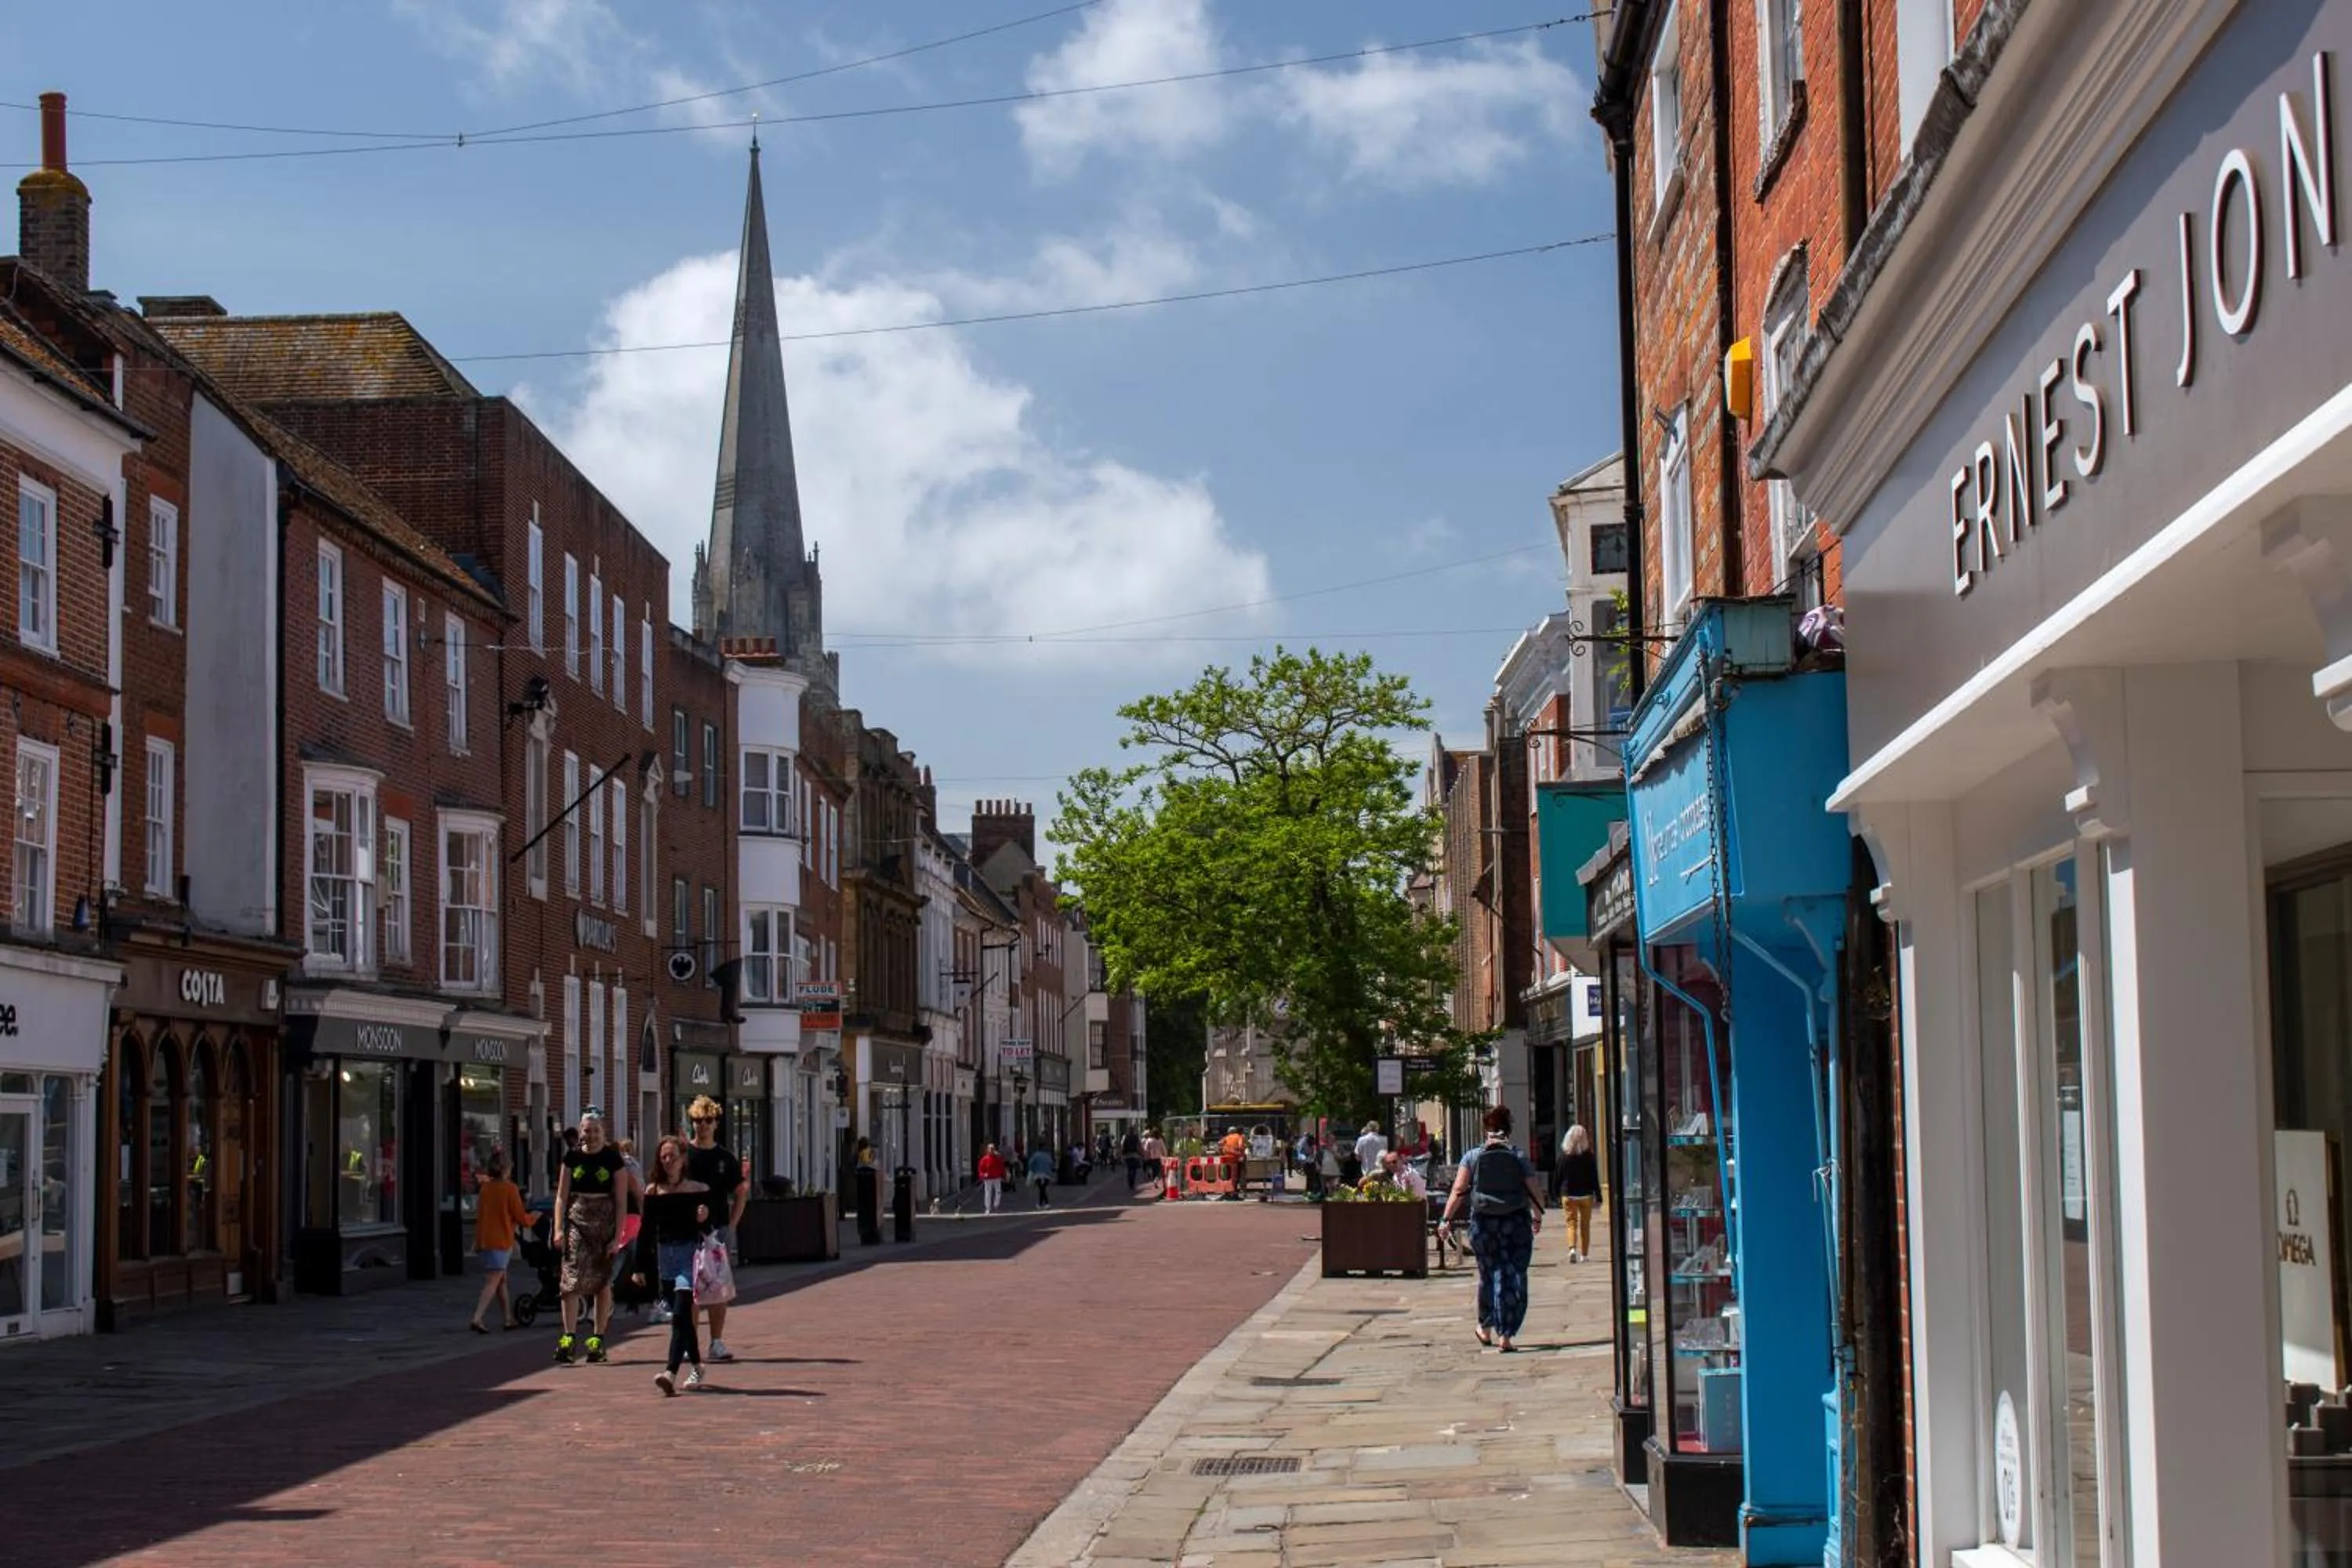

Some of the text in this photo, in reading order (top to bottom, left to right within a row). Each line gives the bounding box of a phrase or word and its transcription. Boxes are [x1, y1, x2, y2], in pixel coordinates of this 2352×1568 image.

[1951, 51, 2336, 596] ERNEST JON
[181, 969, 224, 1007] COSTA
[799, 985, 835, 994] FLUDE
[356, 1024, 402, 1052] MONSOON
[474, 1038, 507, 1062] MONSOON
[1002, 1047, 1030, 1056] TO LET
